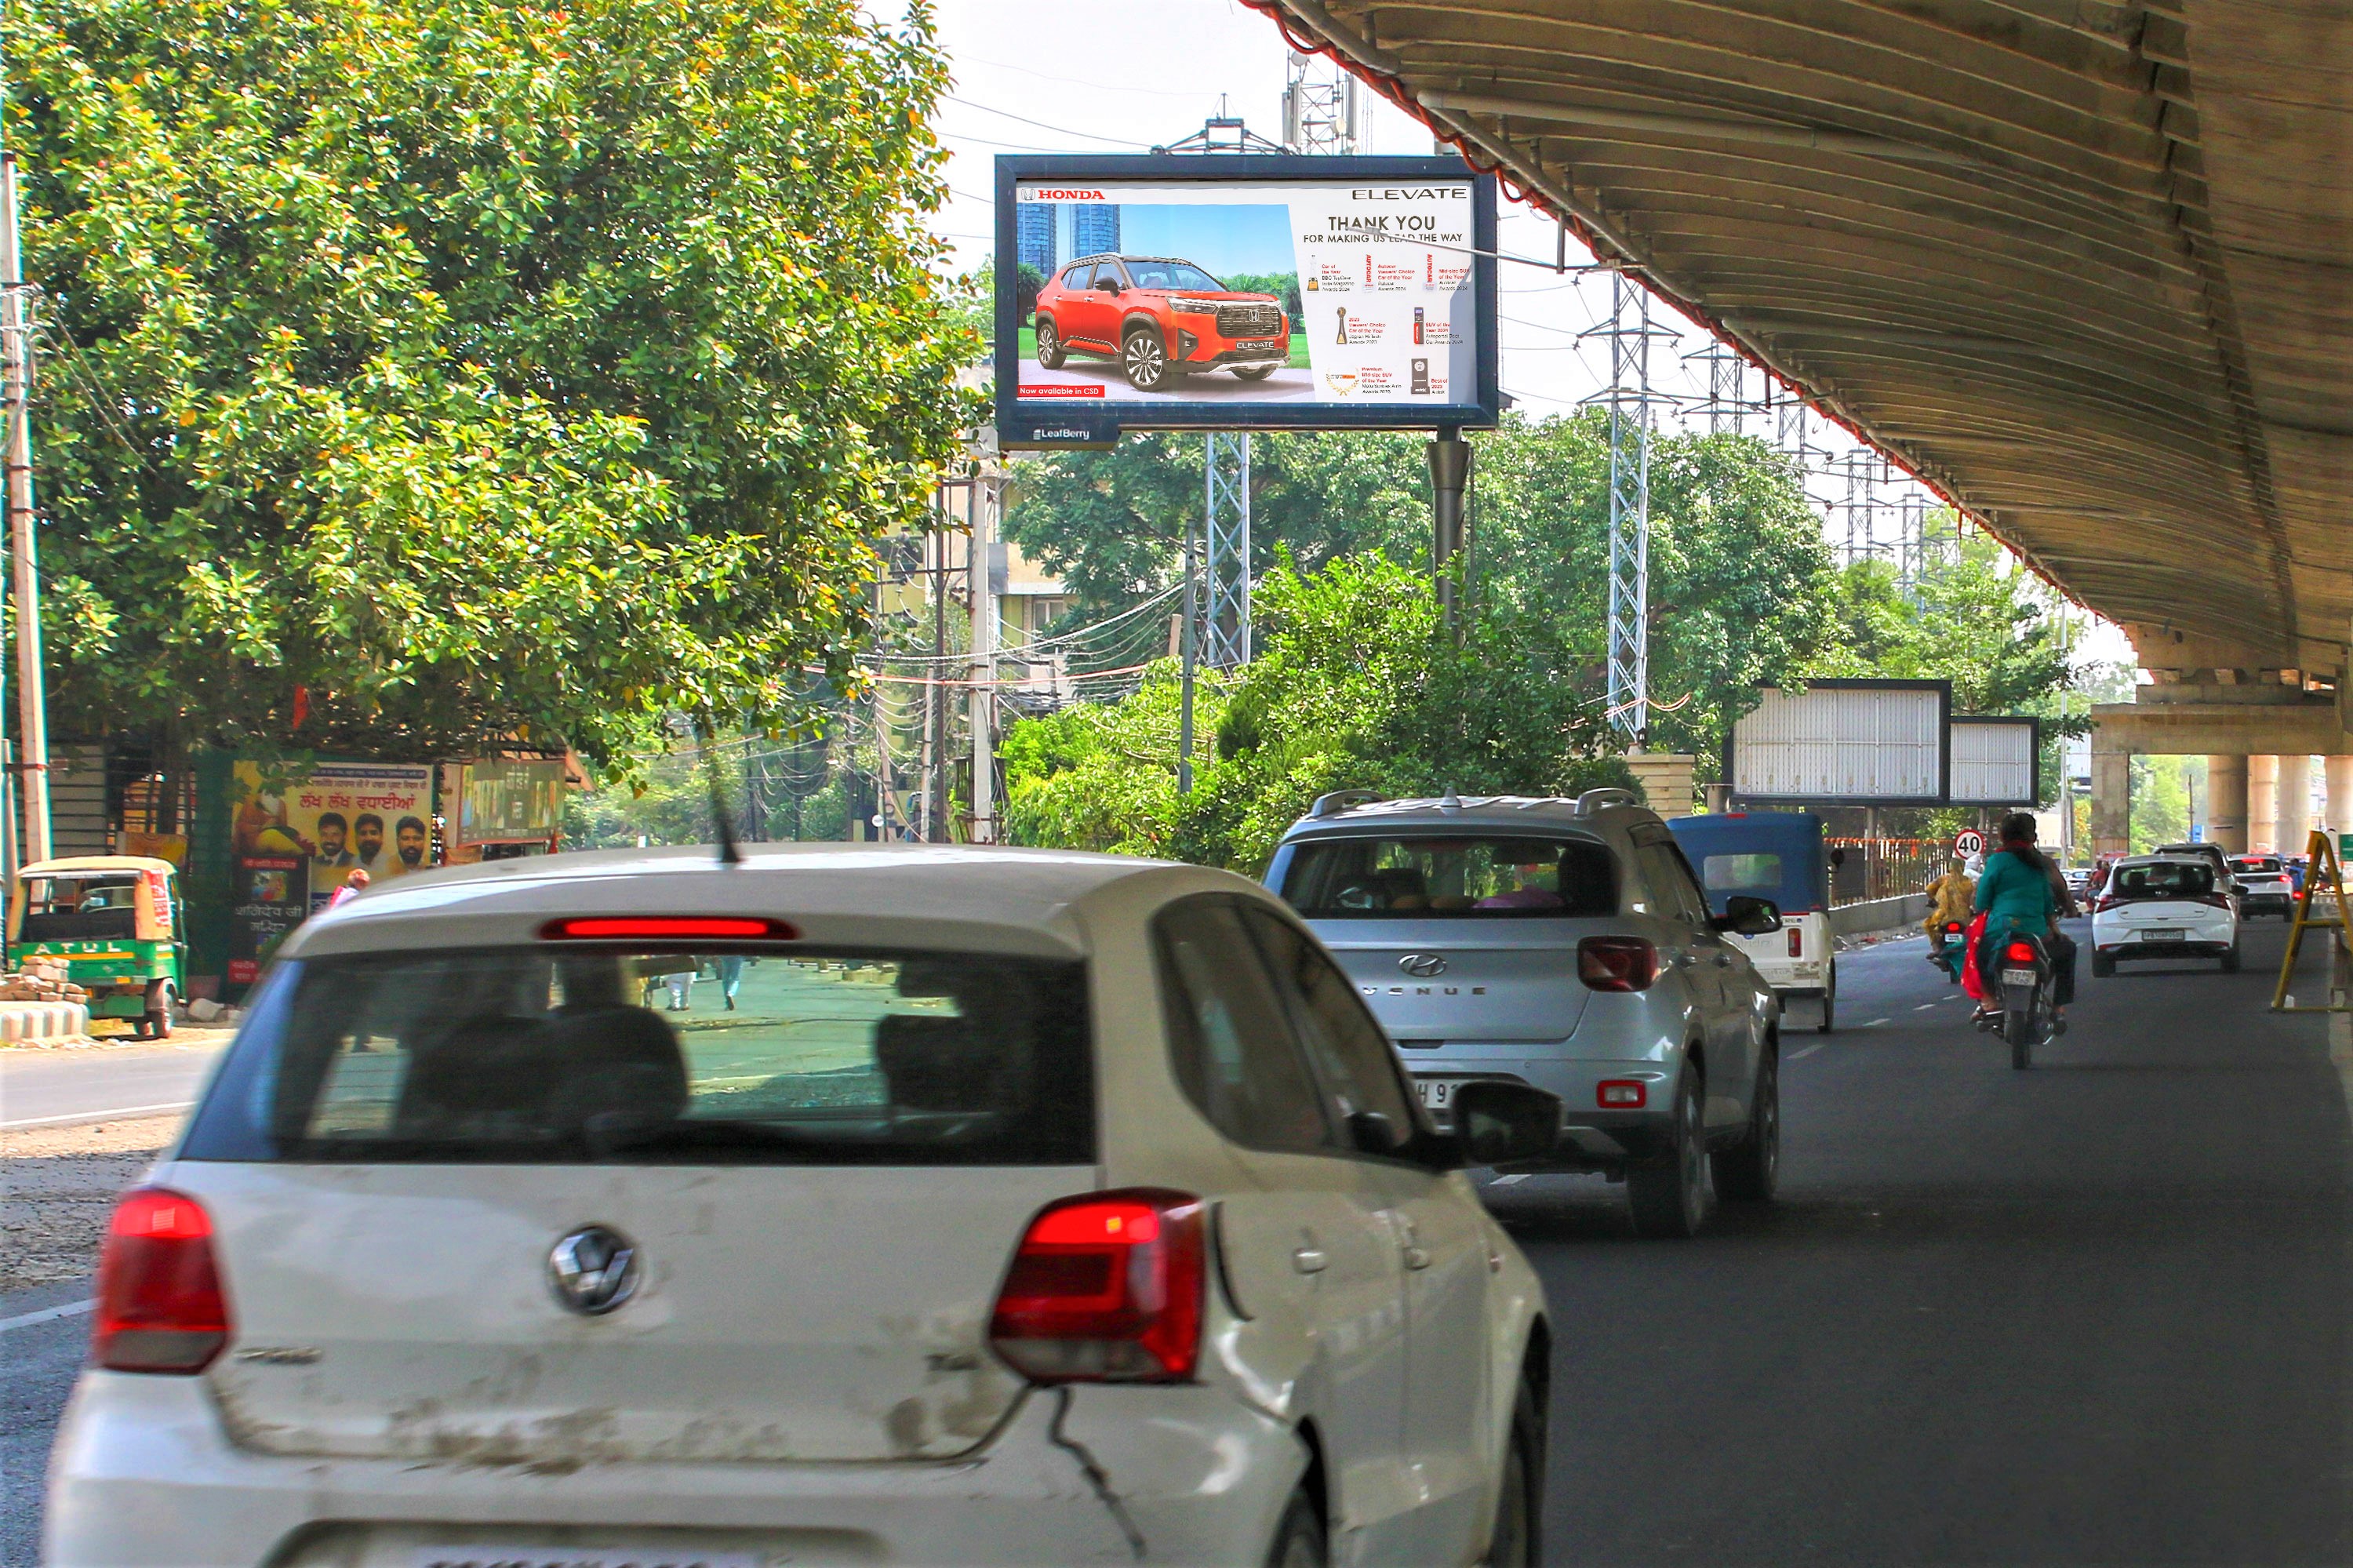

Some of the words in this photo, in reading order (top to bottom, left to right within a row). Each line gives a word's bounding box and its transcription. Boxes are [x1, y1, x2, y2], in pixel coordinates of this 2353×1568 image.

[1038, 190, 1105, 200] HONDA
[1352, 188, 1467, 200] ELEVATE
[1328, 216, 1389, 231] THANK
[1395, 215, 1435, 231] YOU
[1304, 235, 1324, 243] FOR
[1327, 235, 1369, 243] MAKING
[1419, 234, 1437, 242] THE
[1441, 234, 1463, 242] WAY
[1042, 429, 1090, 440] LeafBerry
[1958, 836, 1980, 853] 40
[35, 941, 122, 955] ATUL
[1362, 987, 1486, 995] VENUE
